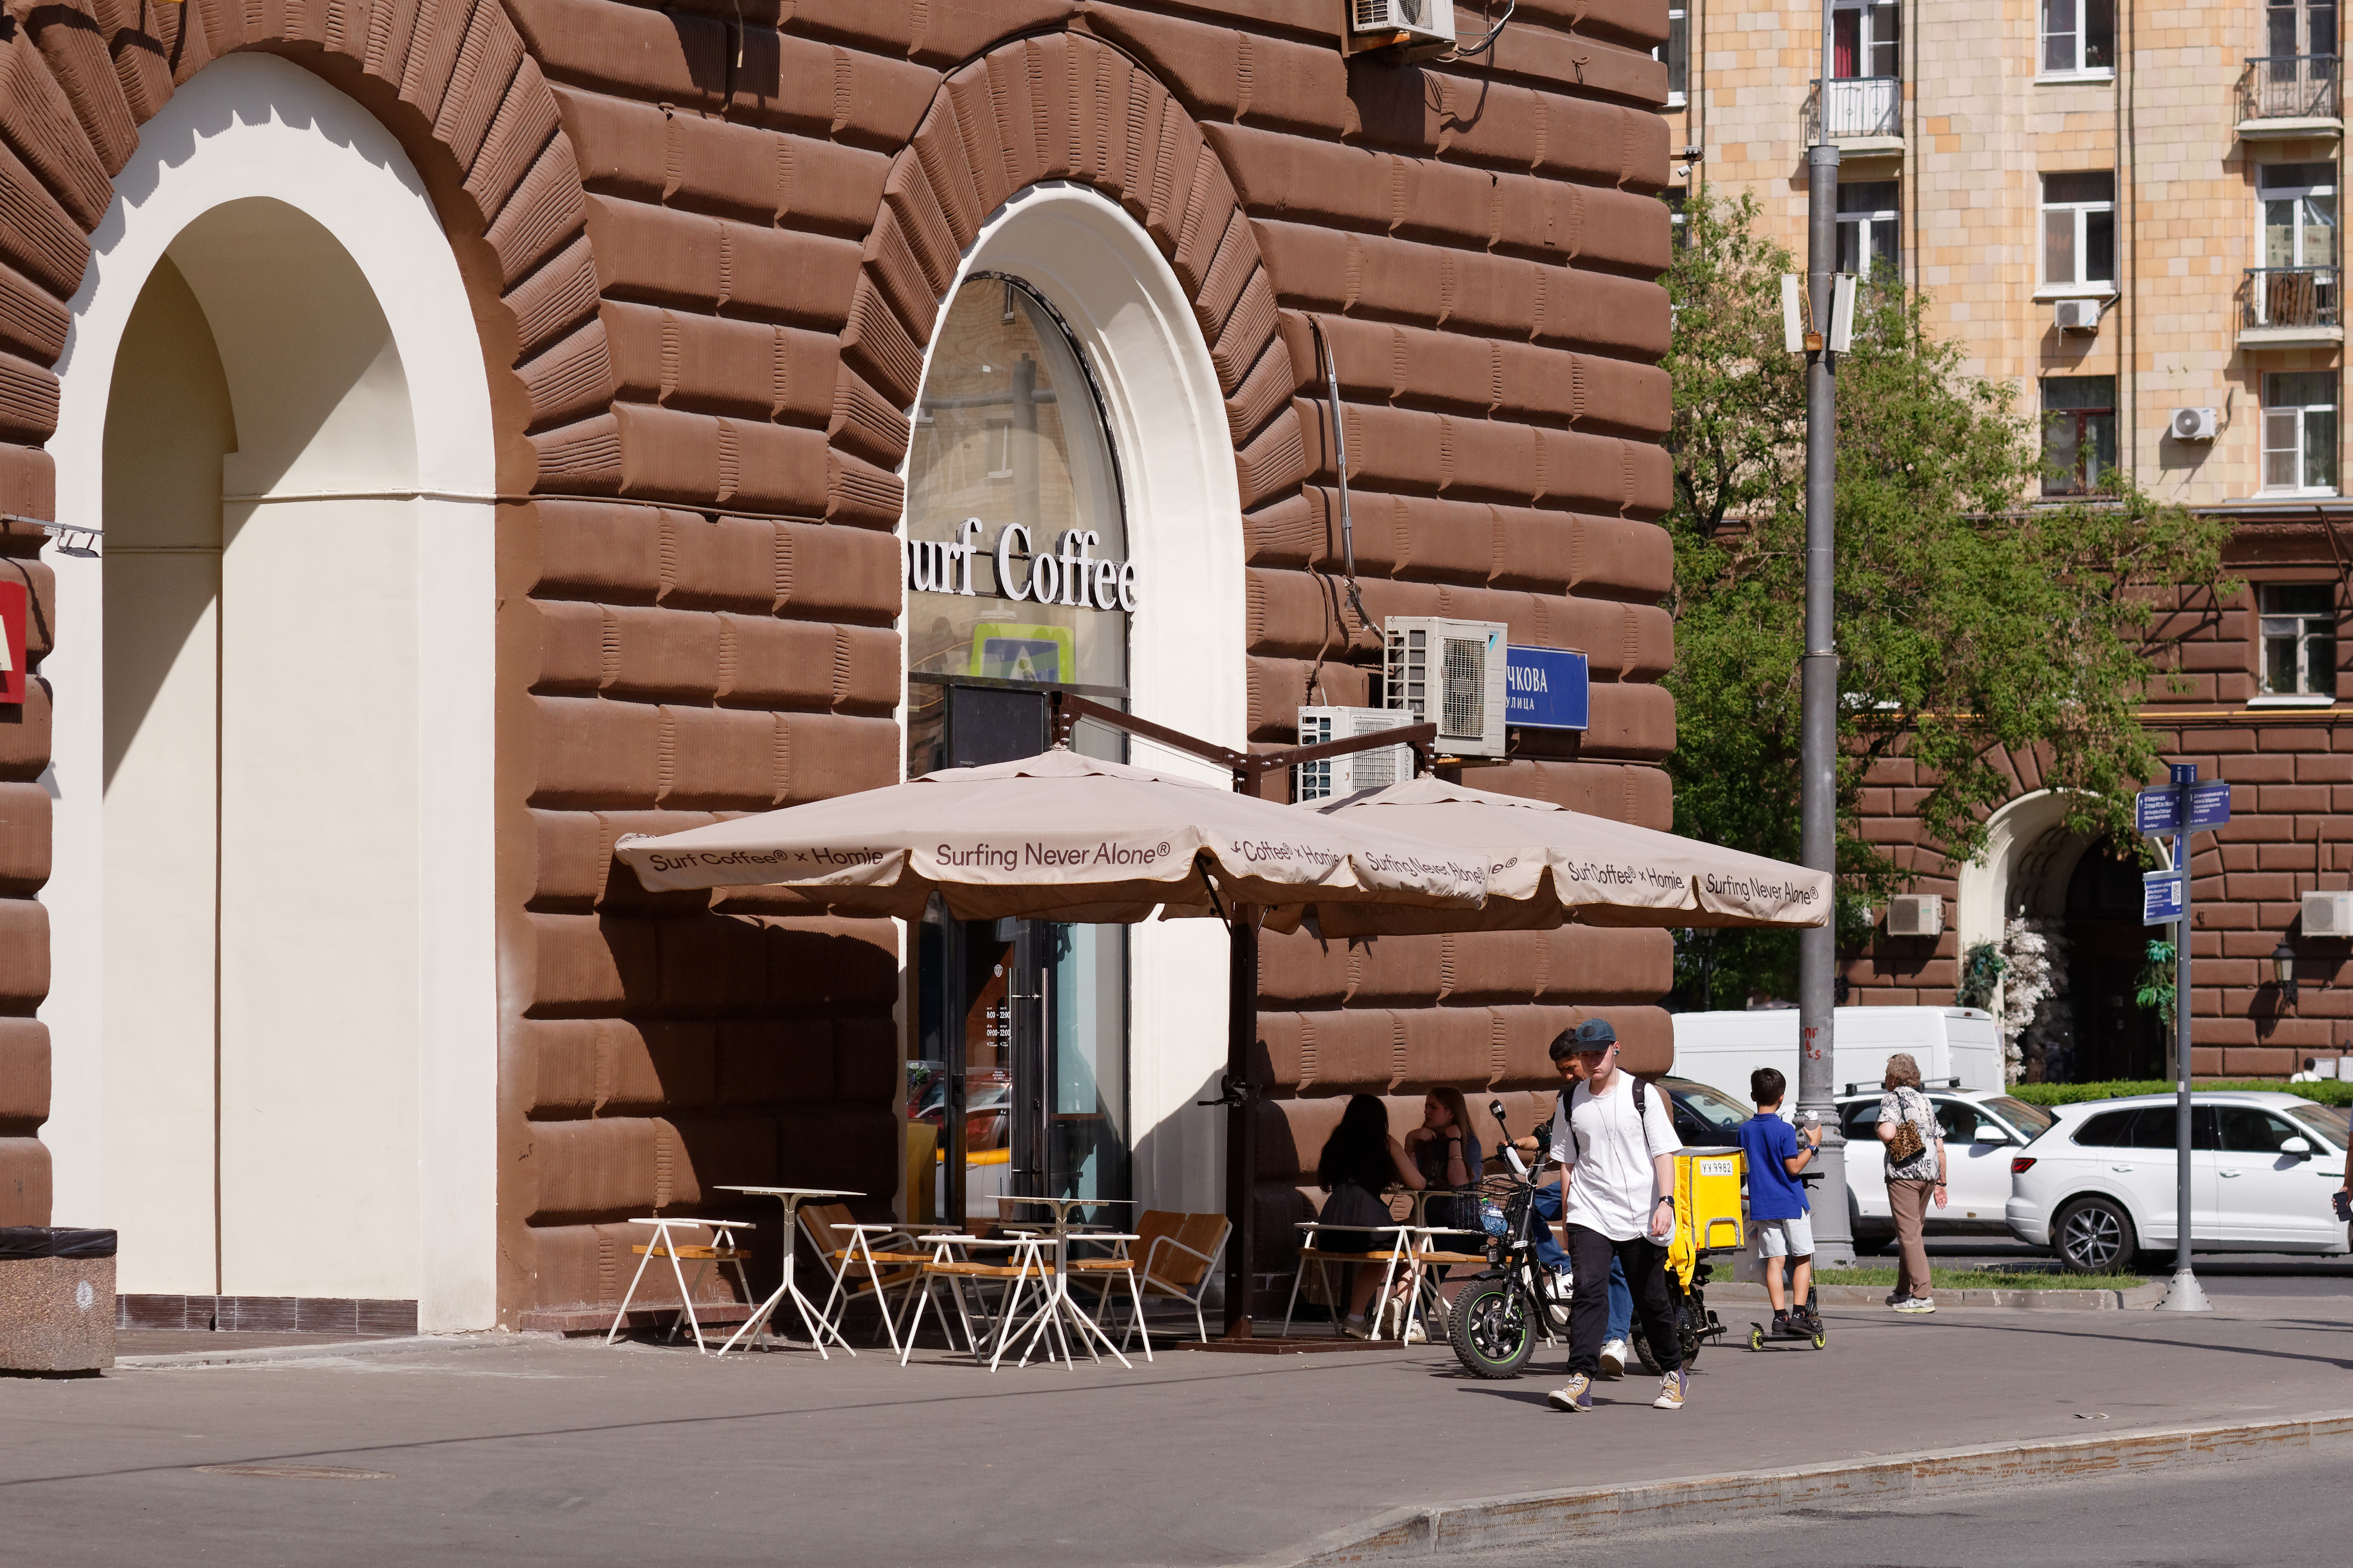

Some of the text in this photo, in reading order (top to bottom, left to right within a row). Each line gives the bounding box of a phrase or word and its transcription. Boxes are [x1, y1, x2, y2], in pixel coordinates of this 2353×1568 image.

[907, 517, 1140, 612] urf Coffee
[1507, 666, 1548, 693] ЧКОВА
[1506, 696, 1535, 711] УЛИЦА
[649, 853, 696, 872] Surf
[811, 847, 884, 866] Homie
[936, 843, 1018, 871] Surfing
[1025, 842, 1090, 865] Never
[1365, 852, 1418, 877] Surfing
[1408, 857, 1451, 876] Never
[1568, 861, 1591, 882] Surf
[1646, 867, 1685, 889] Homie
[1706, 873, 1751, 902] Surfing
[1749, 877, 1782, 900] Never
[1713, 1163, 1731, 1173] 9982
